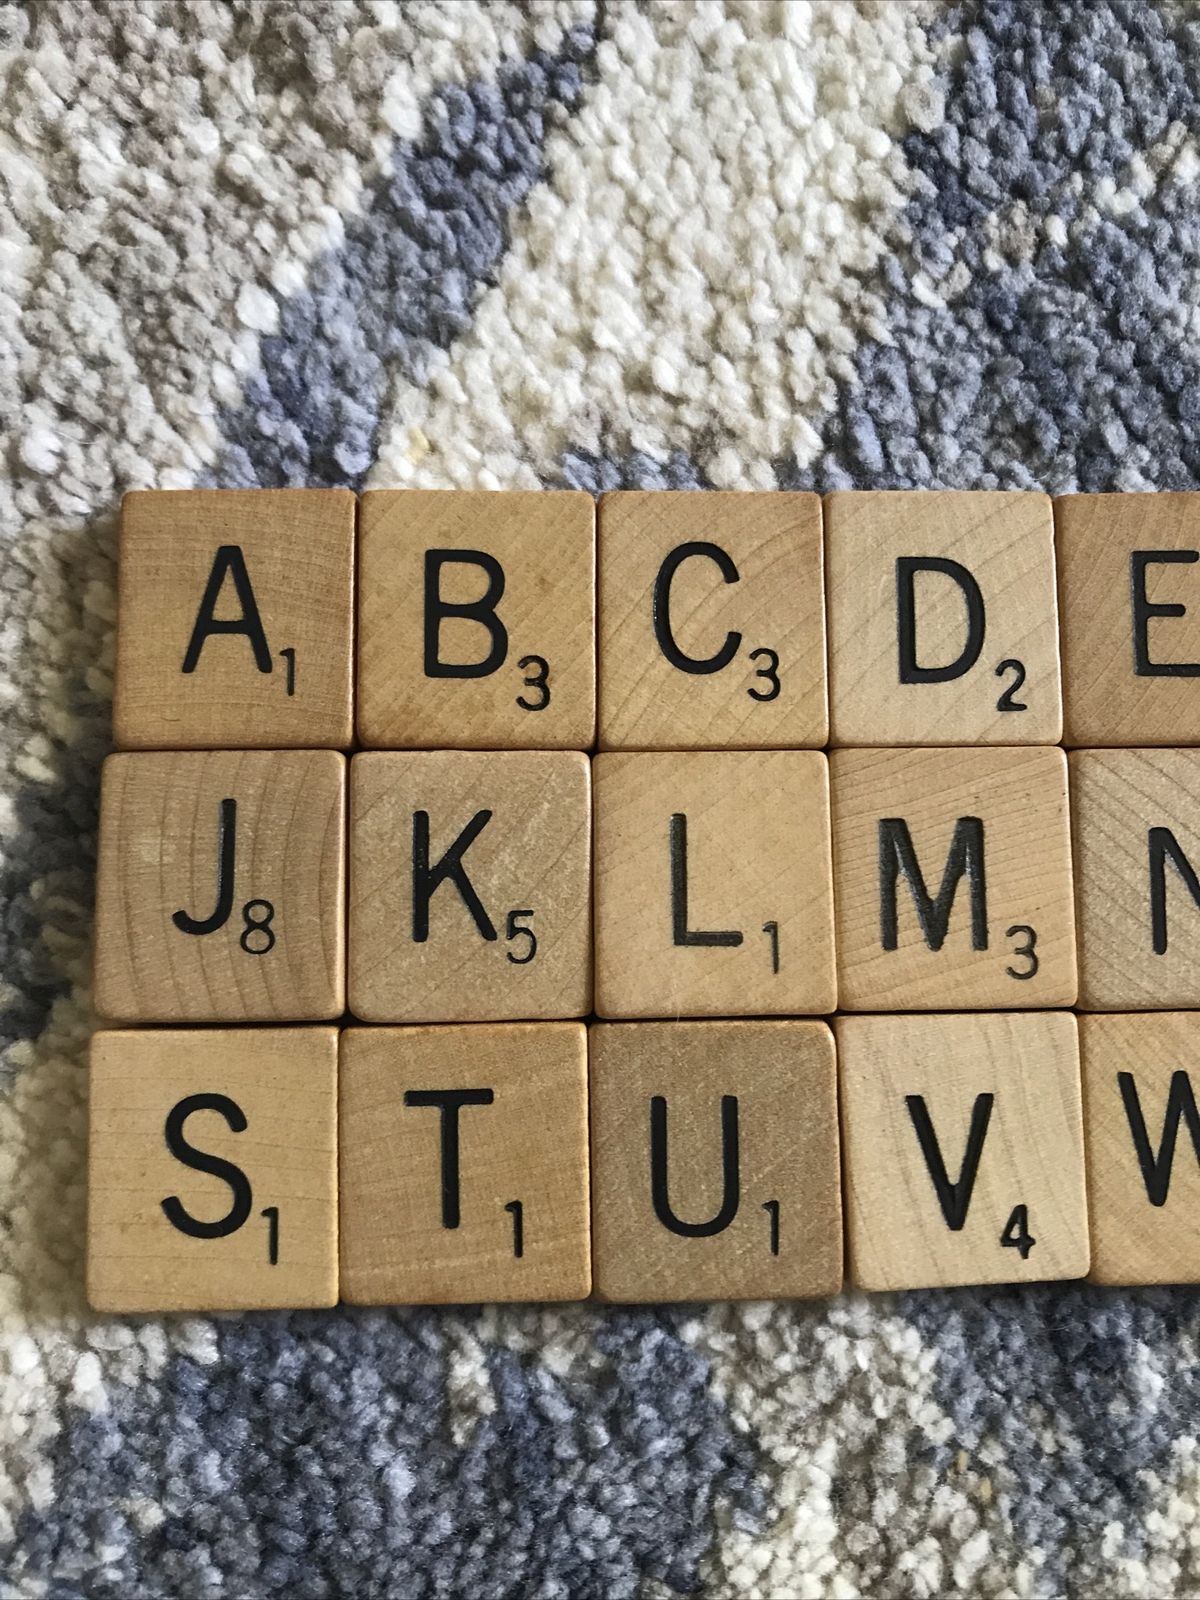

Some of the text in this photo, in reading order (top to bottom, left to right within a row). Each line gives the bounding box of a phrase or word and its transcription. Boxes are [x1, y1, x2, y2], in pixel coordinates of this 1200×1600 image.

[182, 545, 296, 696] A 1
[424, 549, 550, 711] B 3
[653, 541, 780, 702] C 3
[896, 556, 1028, 711] D 2
[1131, 550, 1200, 677] E
[171, 798, 275, 956] J 8
[411, 809, 538, 965] K 5
[670, 812, 780, 974] L 1
[879, 816, 1038, 980] M 3
[160, 1093, 279, 1265] S 1
[403, 1087, 523, 1258] T 1
[650, 1095, 780, 1256] U 1
[905, 1093, 1036, 1260] V 4
